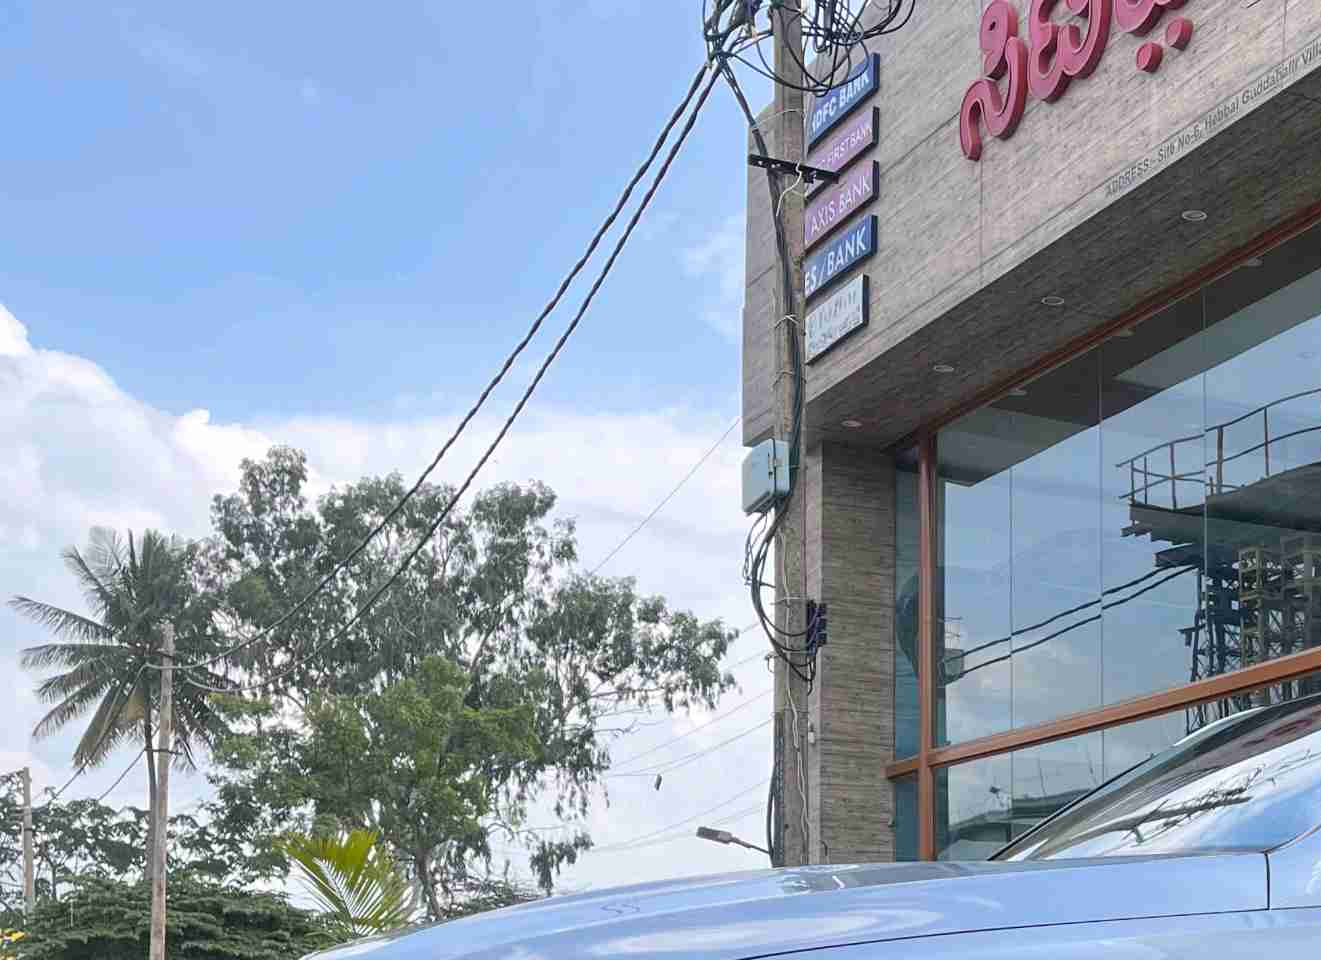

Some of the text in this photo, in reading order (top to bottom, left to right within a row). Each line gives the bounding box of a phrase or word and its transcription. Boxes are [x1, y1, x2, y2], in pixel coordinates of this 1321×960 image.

[839, 71, 869, 109] BANK
[811, 176, 871, 235] AXIS BANK
[827, 226, 866, 275] BANK
